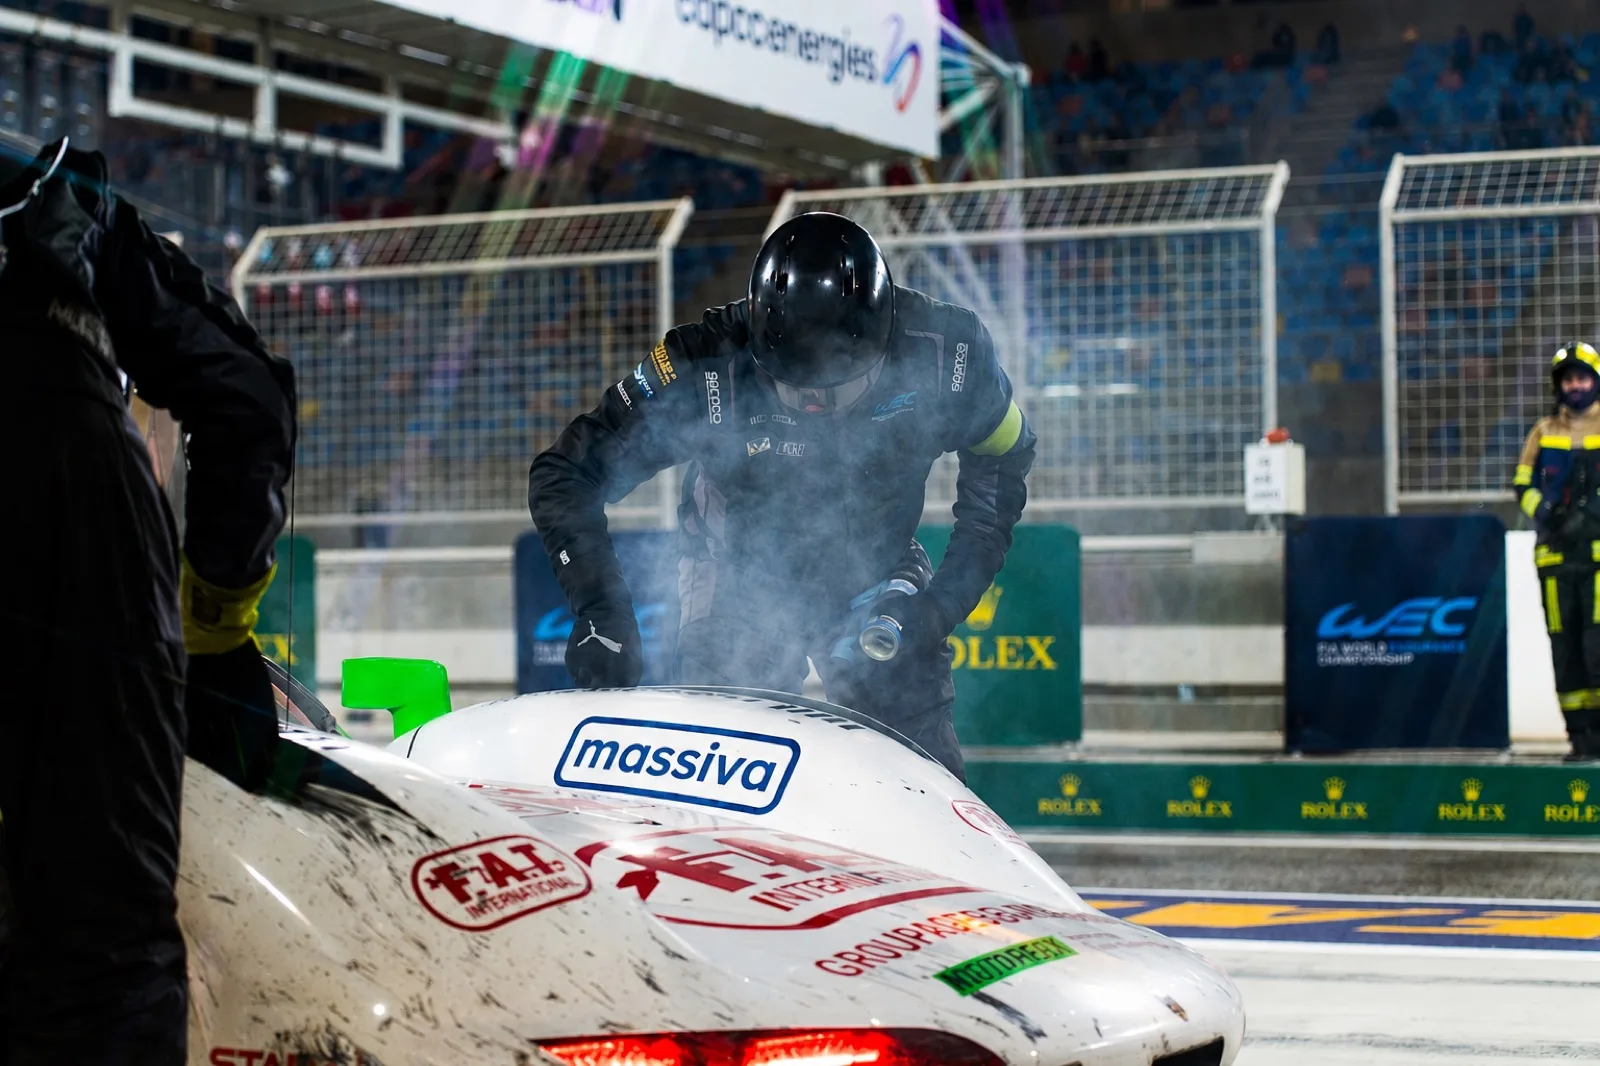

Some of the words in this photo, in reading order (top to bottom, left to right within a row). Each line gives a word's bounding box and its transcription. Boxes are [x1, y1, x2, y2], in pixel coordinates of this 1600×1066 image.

[1317, 596, 1477, 638] WEC
[946, 636, 1057, 669] OLEX
[573, 738, 777, 792] massiva
[1037, 799, 1102, 816] ROLEX
[1167, 801, 1232, 818] ROLEX
[1301, 802, 1368, 819] ROLEX
[1438, 803, 1506, 821] ROLEX
[1544, 804, 1600, 822] ROLE
[465, 876, 582, 920] INTERNATIONAL
